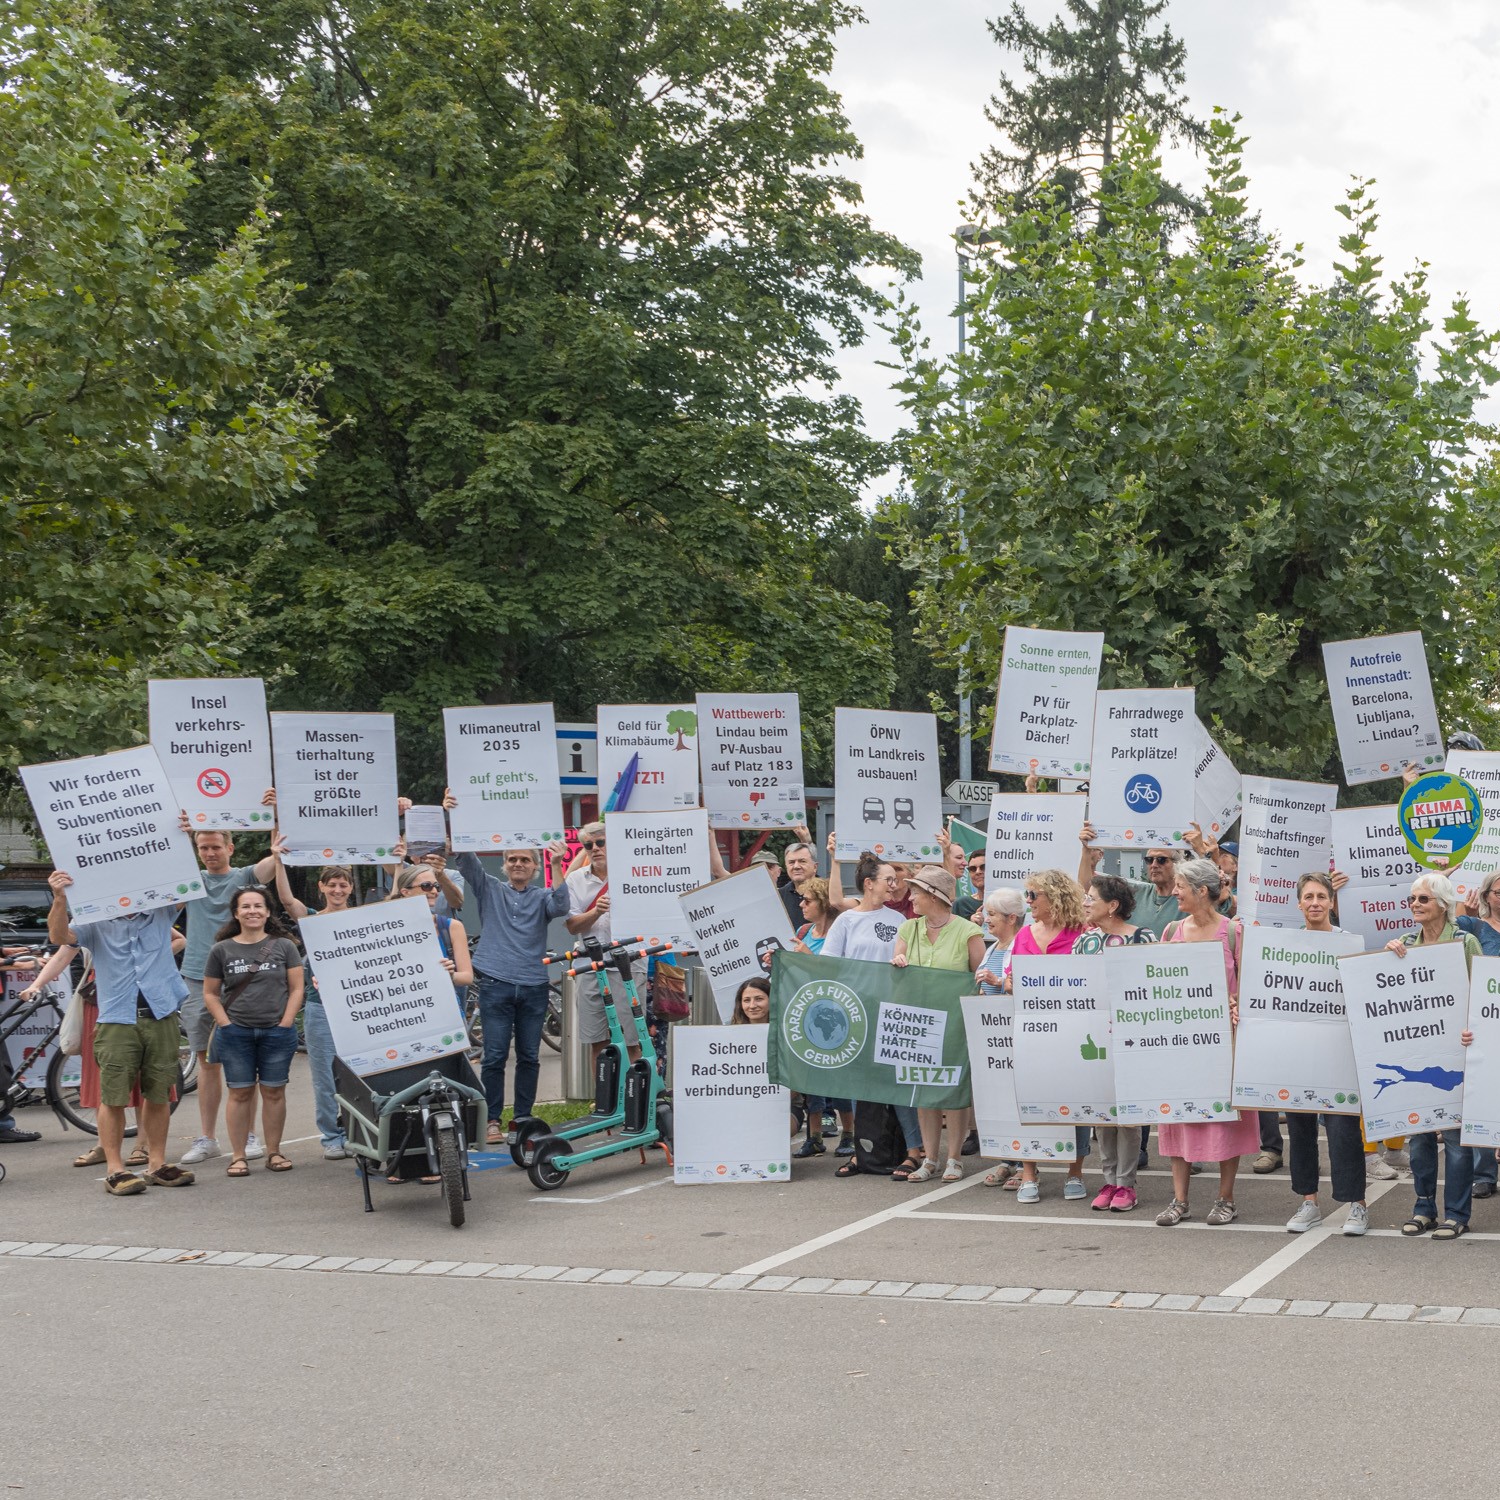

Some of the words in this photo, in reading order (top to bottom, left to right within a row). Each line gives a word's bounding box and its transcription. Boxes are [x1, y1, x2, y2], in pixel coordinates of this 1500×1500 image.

[1019, 643, 1054, 658] Sonne
[1057, 648, 1092, 661] ernten,
[1350, 652, 1402, 668] Autofreie
[1006, 657, 1056, 674] Schatten
[1058, 664, 1098, 677] spenden
[1345, 669, 1412, 688] Innenstadt:
[191, 695, 227, 710] Insel
[1033, 695, 1050, 708] PV
[1351, 690, 1413, 707] Barcelona,
[711, 707, 786, 720] Wattbewerb:
[1019, 710, 1078, 729] Parkplatz-
[1109, 706, 1184, 723] Fahrradwege
[1356, 709, 1415, 727] Ljubljana,
[175, 717, 246, 732] verkehrs-
[459, 720, 541, 736] Klimaneutral
[617, 720, 641, 731] Geld
[1130, 726, 1159, 739] statt
[305, 730, 364, 743] Massen-
[605, 735, 675, 747] Klimabäume
[870, 726, 901, 741] ÖPNV
[1025, 729, 1070, 745] Dächer!
[1371, 724, 1421, 743] Lindau?
[170, 739, 252, 758] beruhigen!
[482, 739, 521, 752] 2035
[720, 743, 782, 755] PV-Ausbau
[868, 746, 926, 762] Landkreis
[1111, 746, 1178, 762] Parkplätze!
[295, 748, 375, 765] tierhaltung
[734, 760, 763, 772] Platz
[767, 760, 793, 771] 183
[857, 767, 917, 781] ausbauen!
[48, 778, 79, 793] Wir
[83, 768, 142, 787] fordern
[752, 776, 779, 788] 222
[77, 790, 118, 807] Ende
[121, 783, 155, 798] aller
[314, 786, 361, 803] größte
[481, 787, 529, 801] Lindau!
[958, 784, 994, 802] KASSE
[298, 804, 378, 818] Klimakiller!
[1249, 793, 1327, 815] Freiraumkonzept
[1414, 799, 1465, 816] KLIMA
[56, 800, 163, 832] Subventionen
[997, 810, 1018, 821] Stell
[1035, 812, 1054, 823] vor:
[1408, 810, 1472, 831] RETTEN!
[105, 821, 157, 842] fossile
[624, 827, 694, 842] Kleingärten
[1014, 829, 1053, 842] kannst
[1245, 825, 1326, 847] Landschaftsfinger
[75, 833, 171, 869] Brennstoffe!
[633, 842, 687, 857] erhalten!
[993, 848, 1034, 861] endlich
[1256, 843, 1300, 859] beachten
[1432, 842, 1448, 850] BUND
[631, 865, 662, 878] NEIN
[622, 879, 701, 895] Betoncluster!
[1254, 890, 1290, 905] Zubau!
[688, 905, 715, 923] Mehr
[1360, 900, 1396, 914] Taten
[332, 918, 406, 941] Integriertes
[695, 918, 736, 942] Verkehr
[1374, 917, 1417, 931] Worte!
[312, 929, 433, 963] Stadtentwicklungs-
[353, 951, 403, 971] konzept
[709, 955, 751, 978] Schiene
[340, 973, 385, 990] Lindau
[387, 963, 424, 980] 2030
[1145, 964, 1189, 979] Bauen
[1375, 972, 1406, 989] See
[345, 988, 384, 1009] (ISEK)
[1152, 984, 1183, 1000] Holz
[350, 991, 435, 1027] Stadtplanung
[1022, 996, 1062, 1010] reisen
[1364, 994, 1455, 1019] Nahwärme
[790, 988, 815, 1042] PARENTS
[815, 985, 825, 997] 4
[827, 986, 862, 1024] FUTURE
[883, 1006, 936, 1027] KÖNNTE
[1116, 1004, 1224, 1026] Recyclingbeton!
[366, 1011, 428, 1036] beachten!
[882, 1021, 928, 1038] WÜRDE
[1022, 1022, 1058, 1033] rasen
[1383, 1018, 1446, 1044] nutzen!
[708, 1042, 758, 1055] Sichere
[881, 1033, 918, 1050] HÄTTE
[1139, 1034, 1168, 1048] auch
[1192, 1032, 1221, 1046] GWG
[802, 1035, 861, 1065] GERMANY
[879, 1047, 937, 1066] MACHEN.
[898, 1065, 957, 1084] JETZT.
[684, 1082, 781, 1099] verbindungen!
